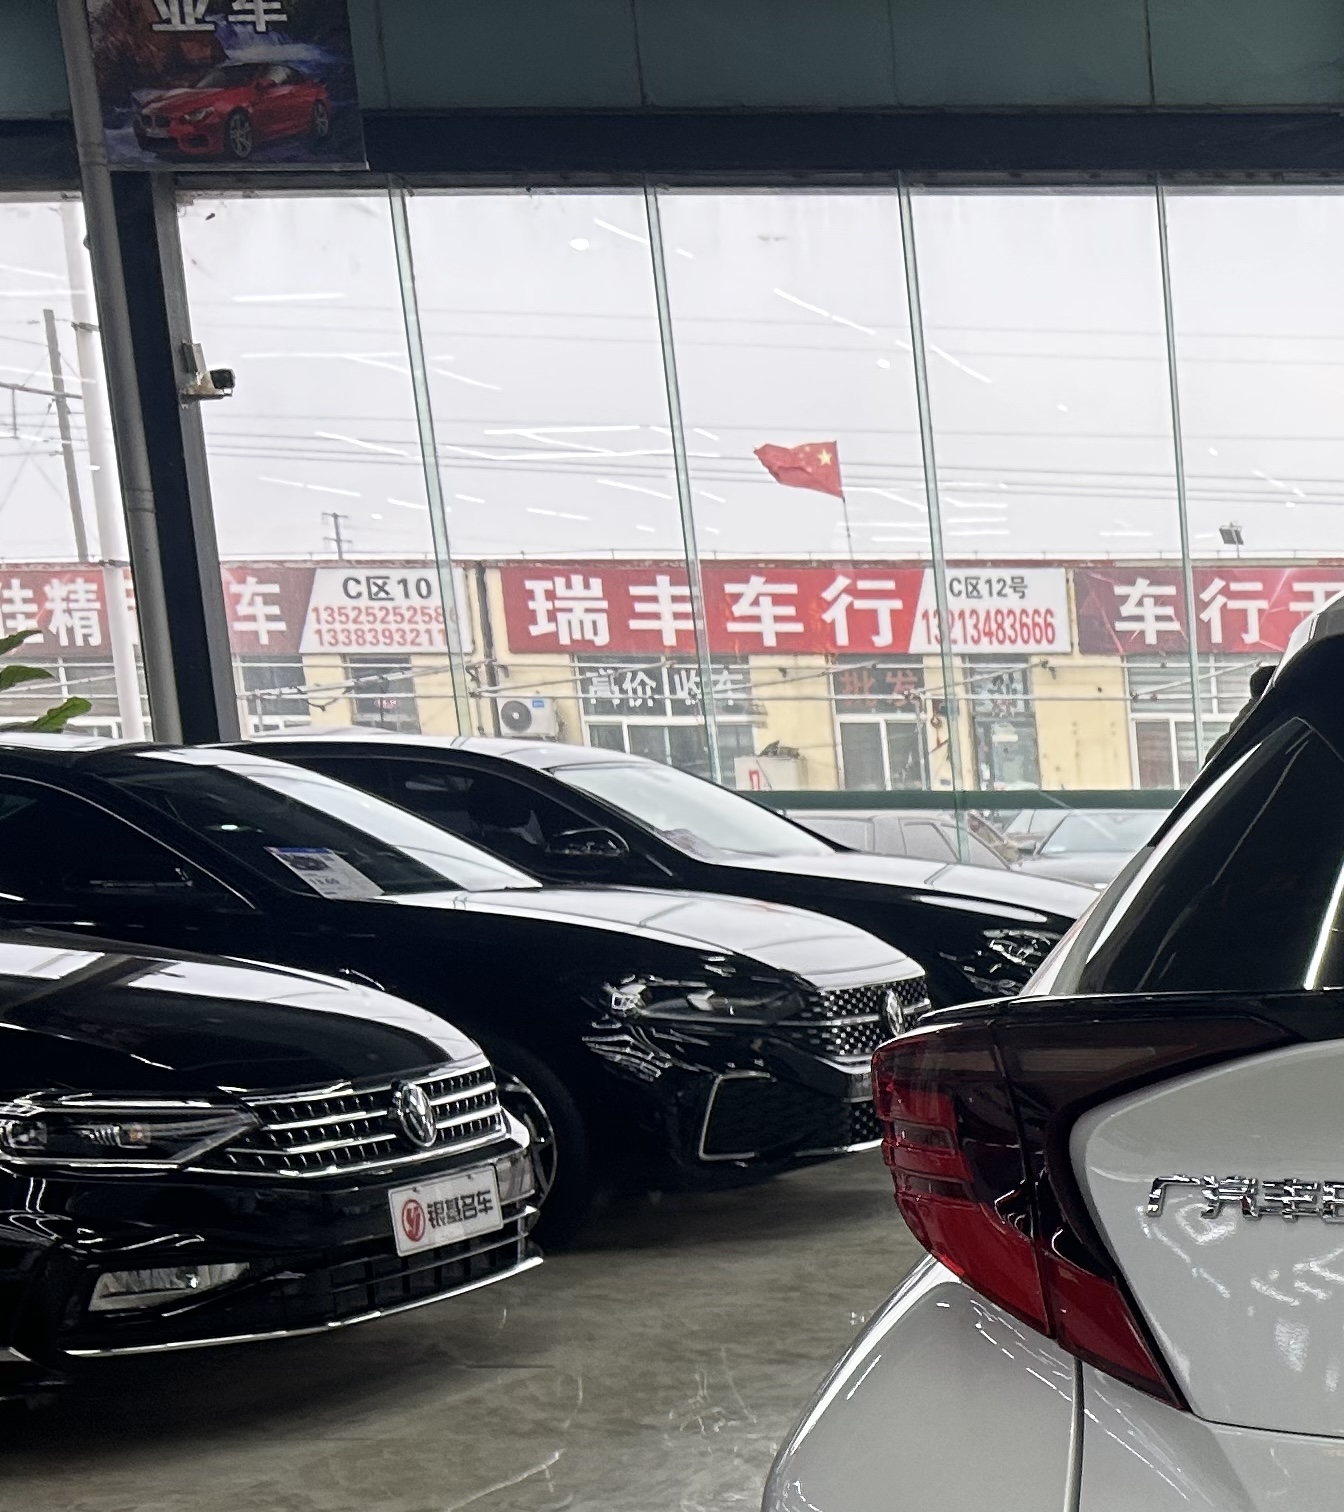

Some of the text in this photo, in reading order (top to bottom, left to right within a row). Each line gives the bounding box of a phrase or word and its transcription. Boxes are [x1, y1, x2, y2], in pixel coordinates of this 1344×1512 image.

[949, 576, 1029, 600] C区12号
[524, 574, 903, 648] 瑞丰车行
[427, 1190, 494, 1229] 银基名车
